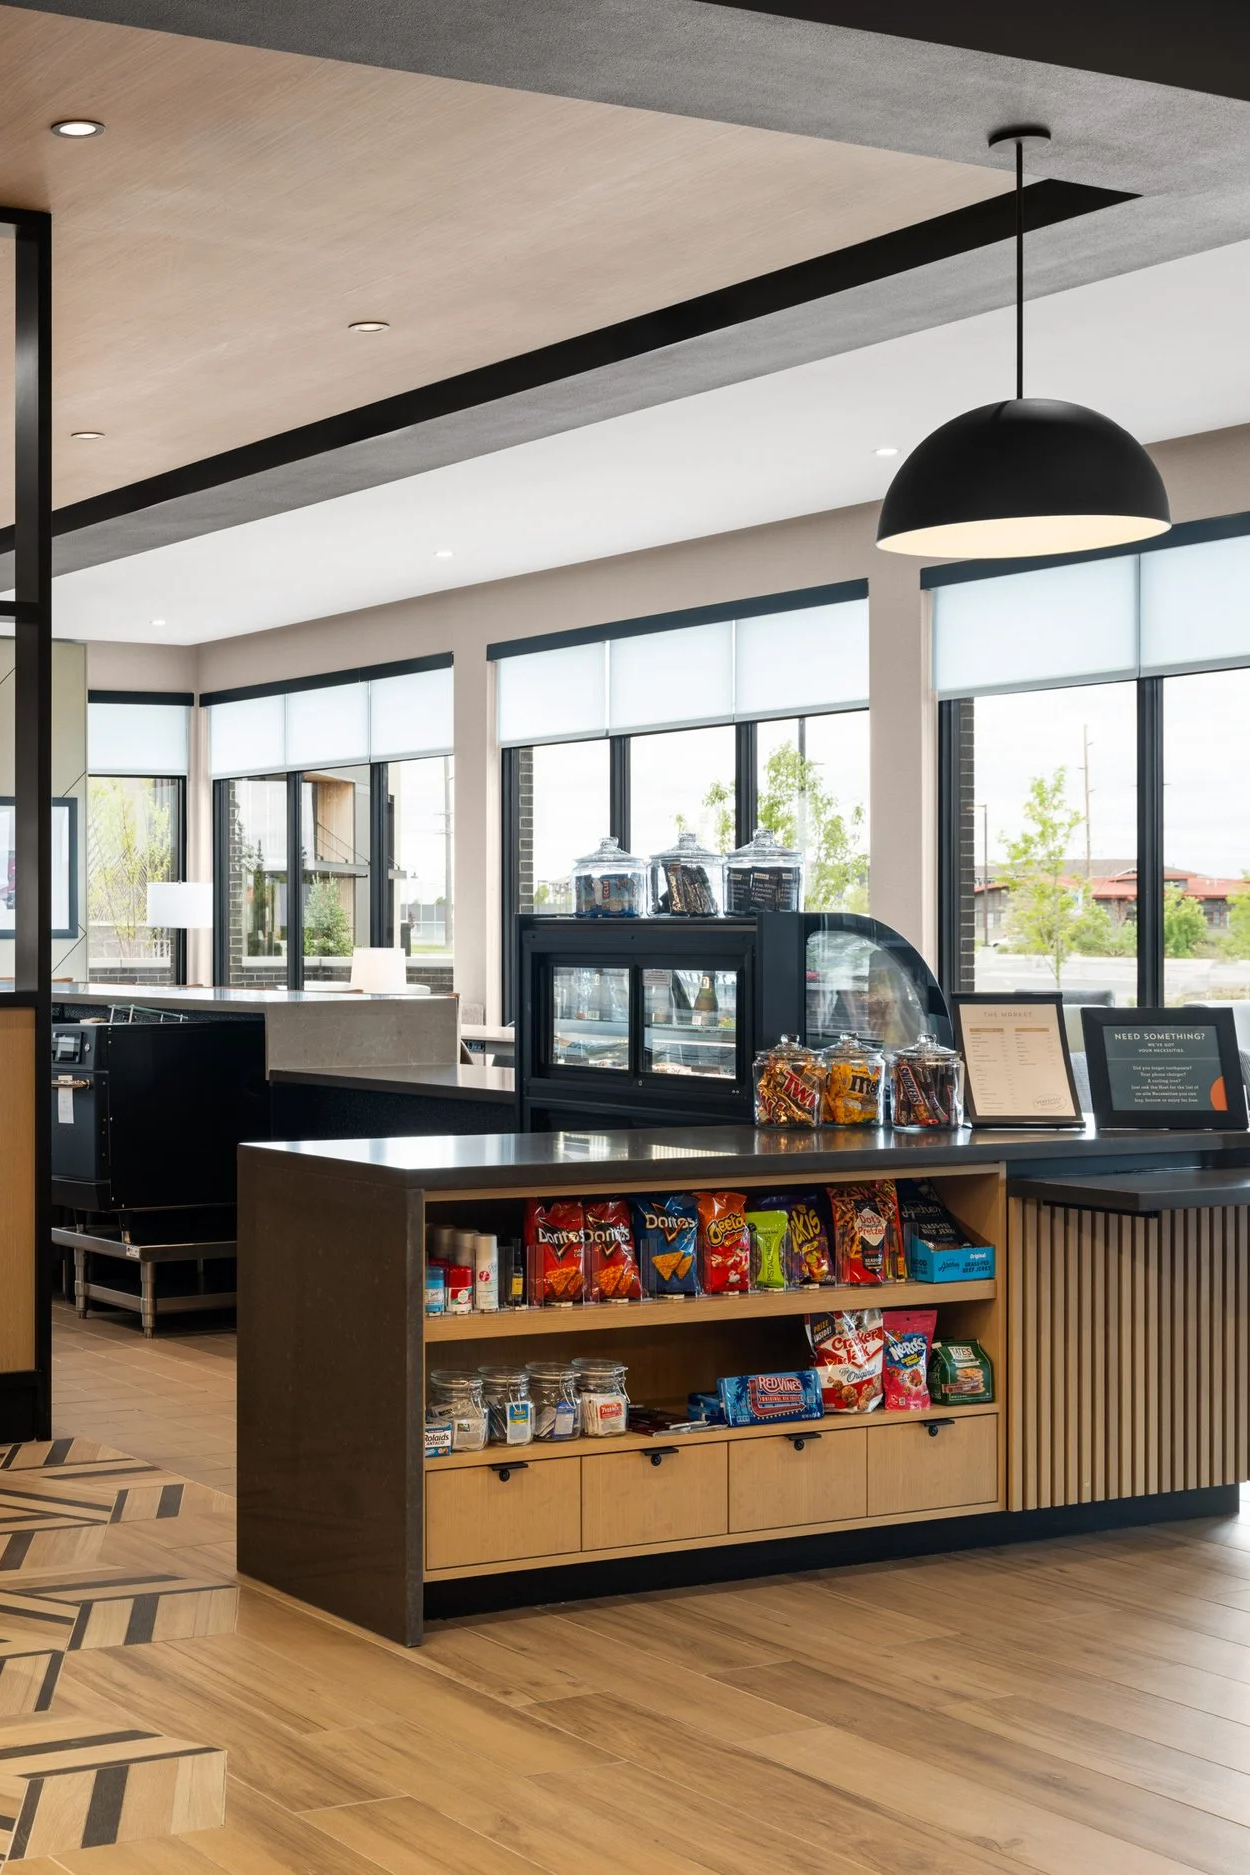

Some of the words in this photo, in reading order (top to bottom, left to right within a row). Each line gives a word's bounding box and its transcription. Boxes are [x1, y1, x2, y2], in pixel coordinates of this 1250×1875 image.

[782, 1070, 817, 1110] TWI
[900, 1067, 923, 1104] SNICKERS
[645, 1213, 696, 1229] Doritos
[859, 1213, 882, 1224] Dot's
[538, 1227, 585, 1244] Doritos
[707, 1213, 744, 1246] Cheeto
[765, 1235, 775, 1281] PISTACHIOS
[831, 1329, 878, 1352] Cracker
[847, 1364, 877, 1383] Original
[759, 1376, 779, 1390] RED
[778, 1377, 802, 1391] VINES
[425, 1433, 449, 1442] Rolaids
